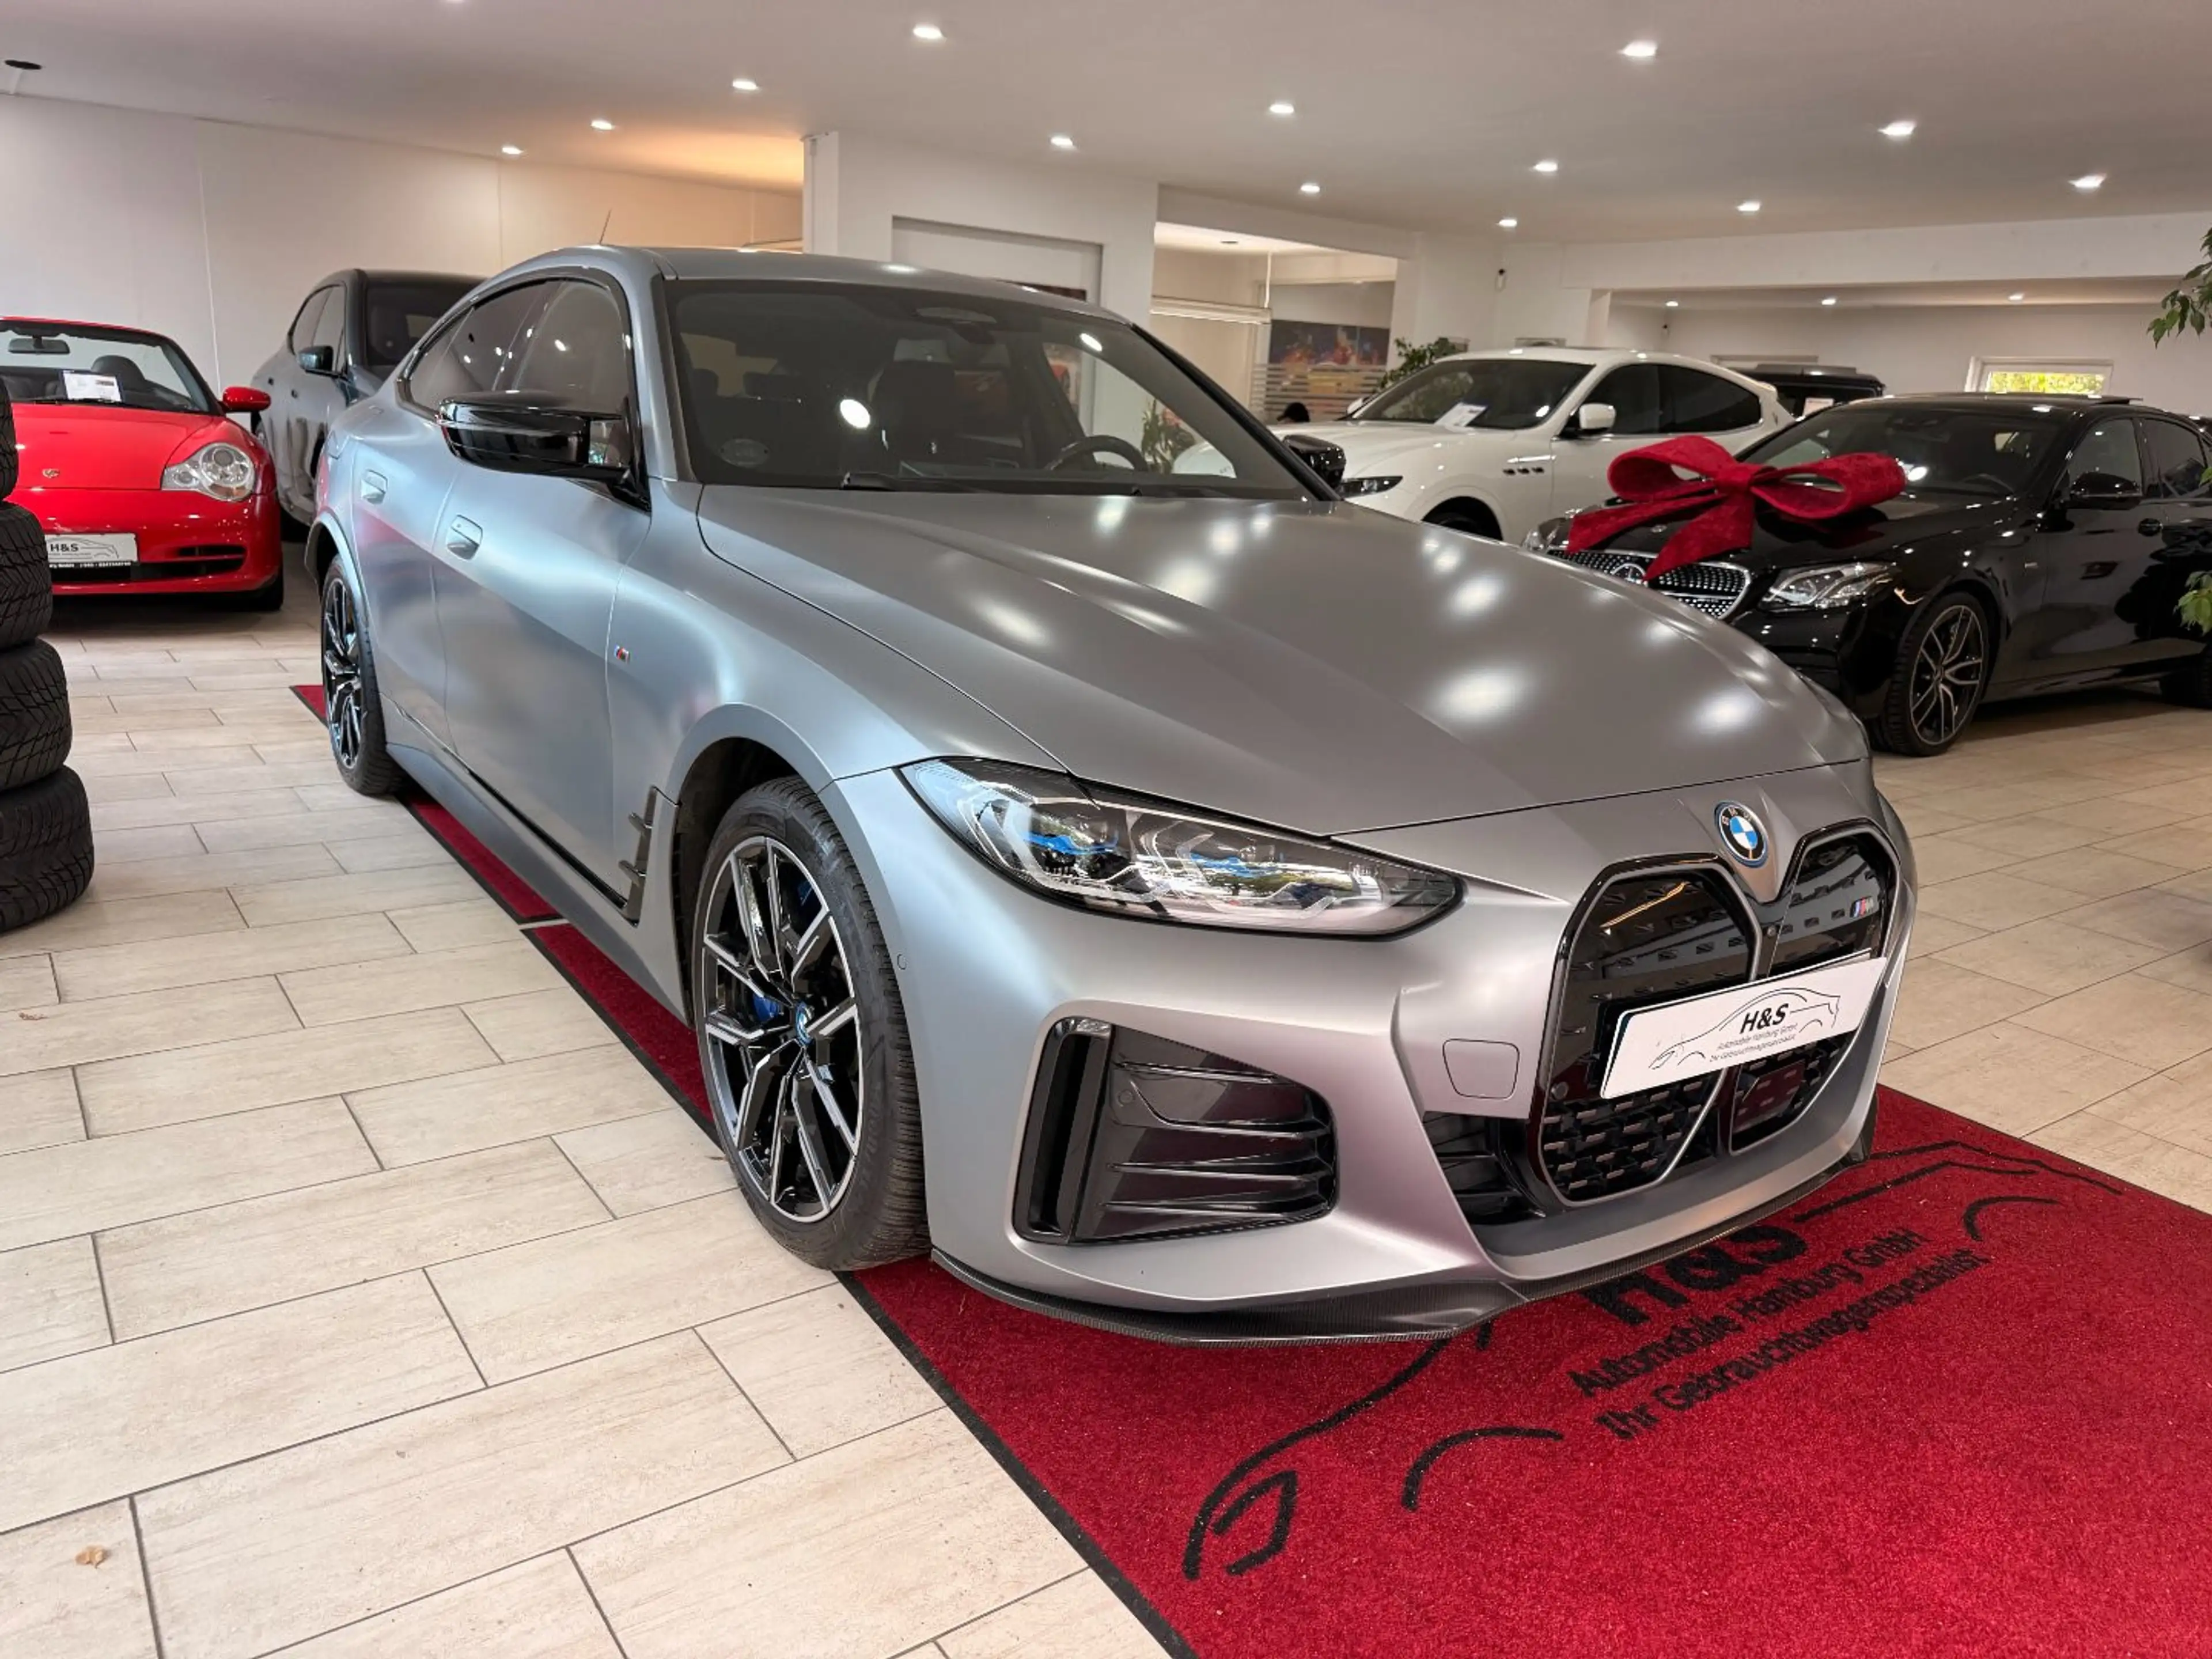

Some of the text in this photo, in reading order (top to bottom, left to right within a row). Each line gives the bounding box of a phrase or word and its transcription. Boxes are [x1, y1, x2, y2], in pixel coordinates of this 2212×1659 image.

[50, 543, 79, 552] H&S
[1739, 1002, 1789, 1035] H&S
[1566, 1227, 1933, 1398] Automobile Hamburg GmbH
[1594, 1403, 1661, 1440] Ihr
